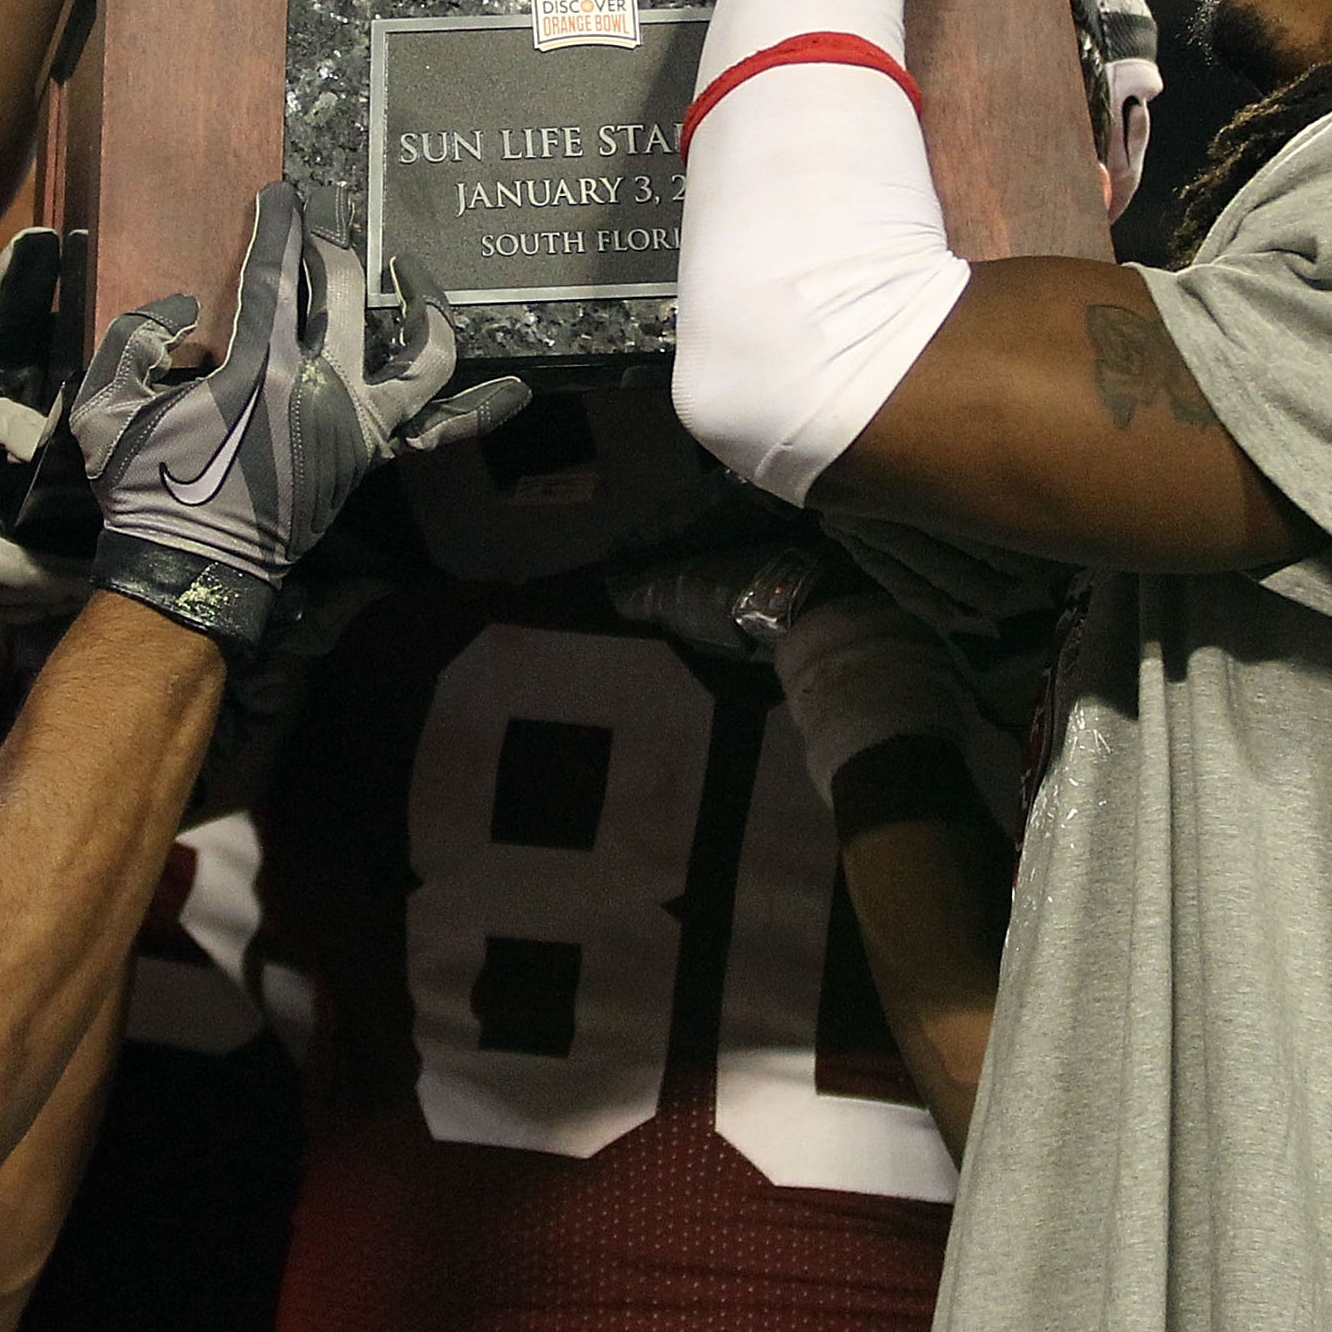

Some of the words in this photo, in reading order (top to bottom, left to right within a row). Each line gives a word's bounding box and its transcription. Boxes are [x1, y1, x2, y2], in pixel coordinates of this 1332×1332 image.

[543, 14, 593, 37] ORANGE
[594, 14, 630, 35] BOWL
[399, 129, 484, 165] SUN
[499, 126, 584, 160] LIFE
[456, 177, 625, 218] JANUARY
[634, 175, 661, 205] 3,
[481, 231, 585, 257] SOUTH
